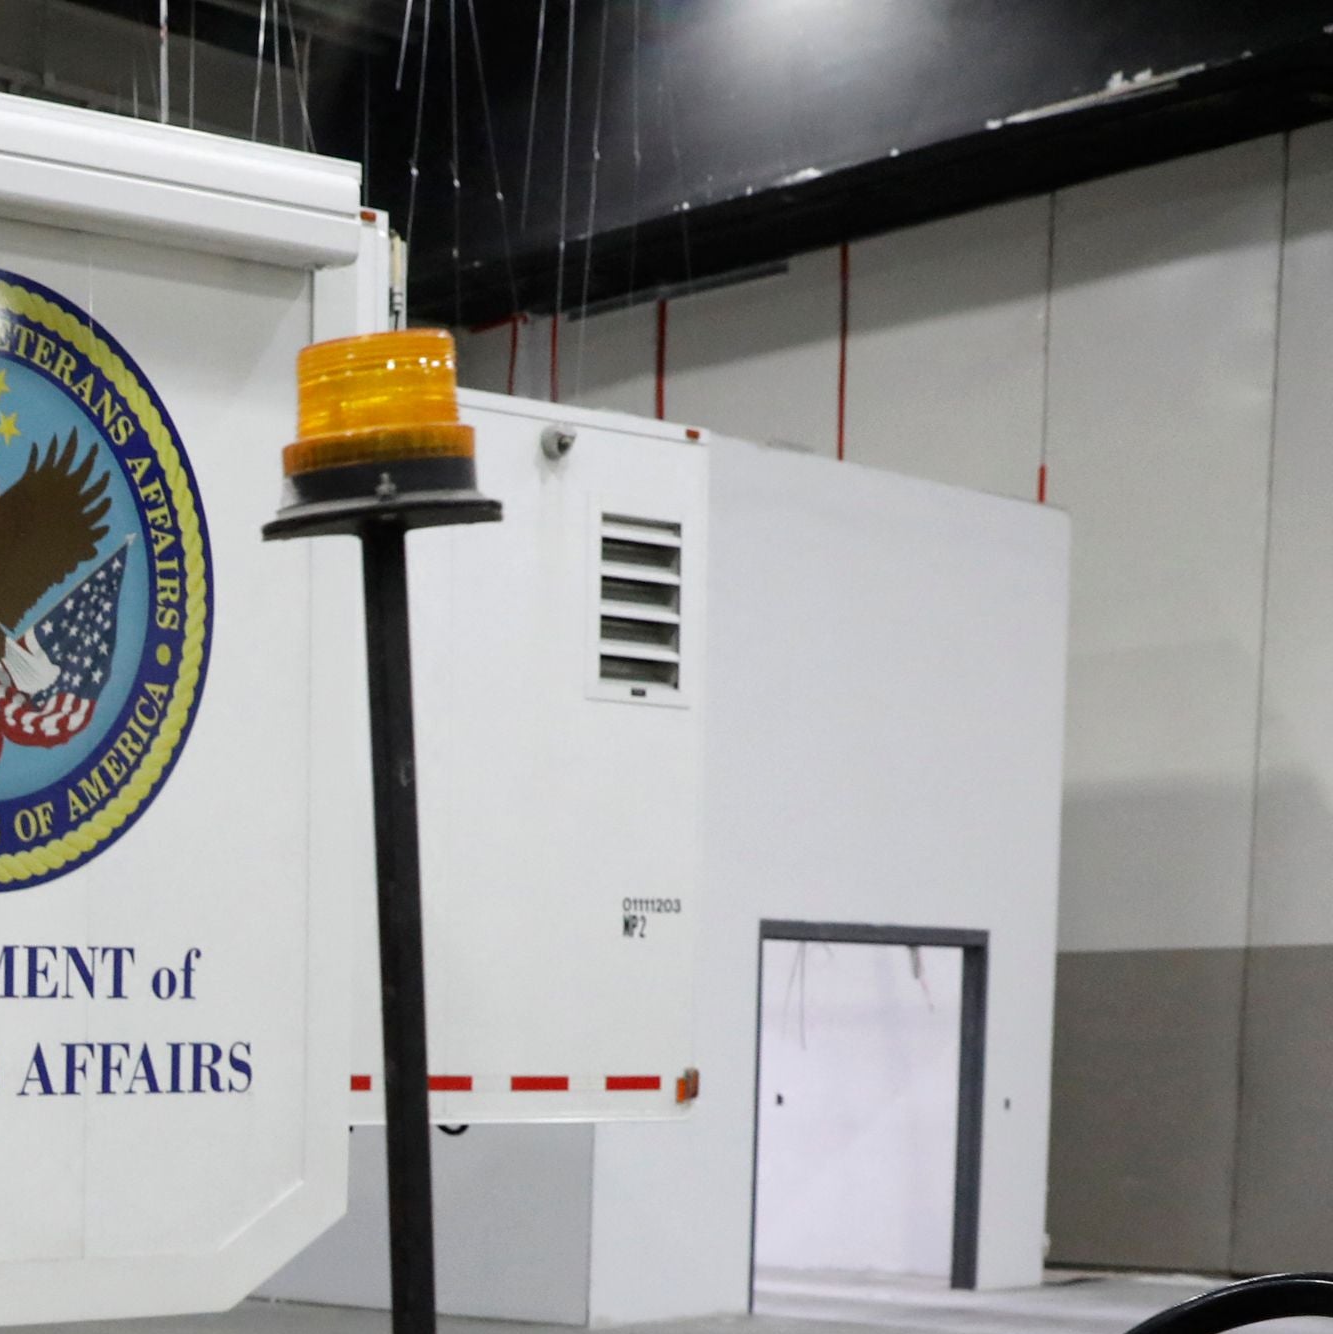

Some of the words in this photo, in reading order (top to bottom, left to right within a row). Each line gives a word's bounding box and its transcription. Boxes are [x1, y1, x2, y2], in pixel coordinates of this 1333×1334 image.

[126, 456, 181, 632] AFFAIRS
[14, 804, 55, 843] OF
[68, 682, 169, 835] AMERICA
[151, 948, 201, 1000] of
[16, 1040, 252, 1096] AFFAIRS
